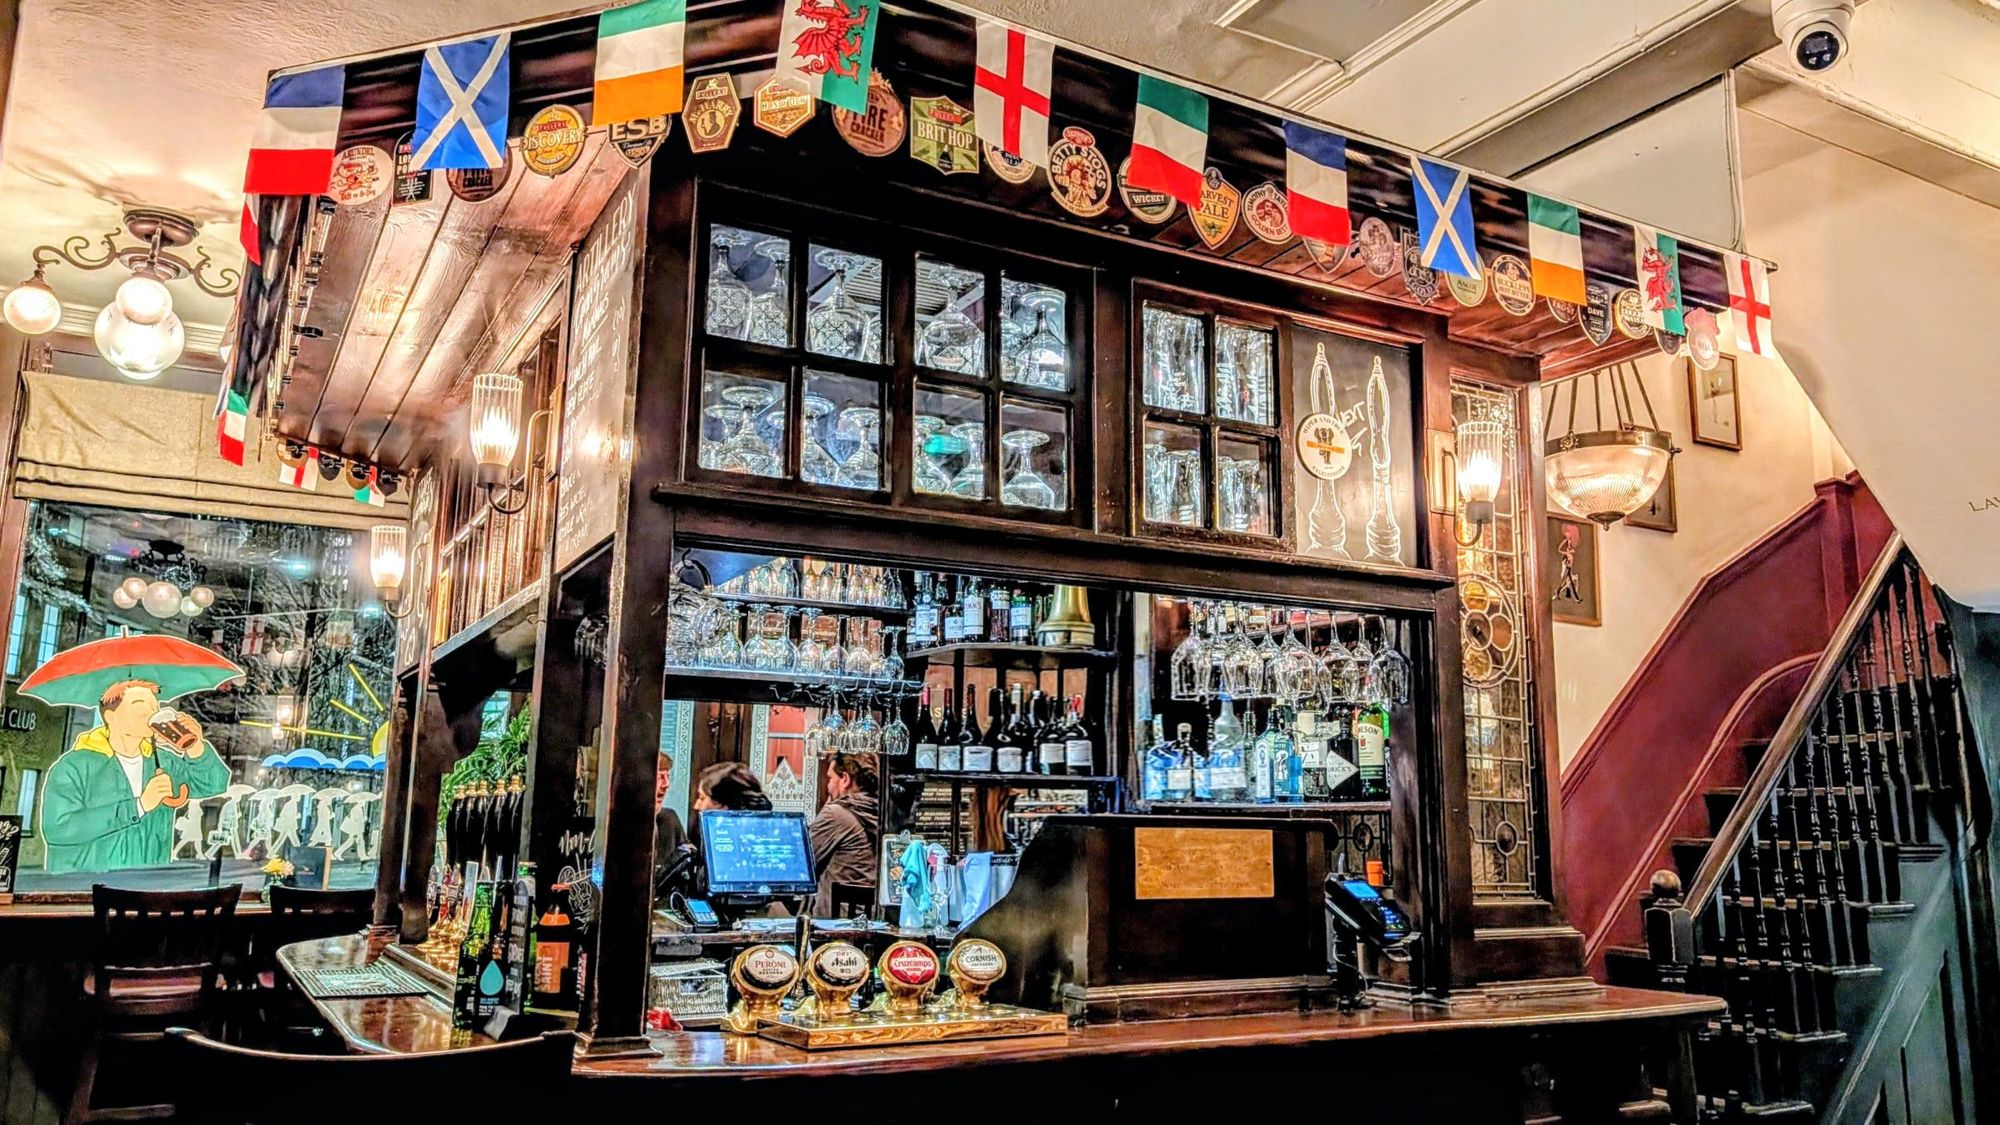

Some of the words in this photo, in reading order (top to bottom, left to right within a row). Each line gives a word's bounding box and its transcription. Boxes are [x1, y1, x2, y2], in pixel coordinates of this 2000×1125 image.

[610, 114, 667, 140] ESB
[850, 121, 885, 143] CRACKER
[918, 121, 946, 143] BRIT
[948, 129, 973, 150] HOP
[520, 128, 584, 151] DISCOVERY
[1052, 143, 1077, 174] BETTY
[1080, 146, 1107, 190] STOGS
[1201, 190, 1234, 206] ARVEST
[1248, 190, 1266, 211] TIMOTHY
[1251, 214, 1275, 236] GOLDEN
[575, 183, 636, 301] ARTILLERY
[1588, 307, 1605, 318] DAVE
[9, 709, 37, 730] CLUB
[755, 960, 786, 969] PERONI
[832, 957, 857, 967] Asahi
[893, 960, 932, 969] Cruzcampo
[966, 954, 997, 963] CORNISH
[541, 956, 553, 991] SAINT
